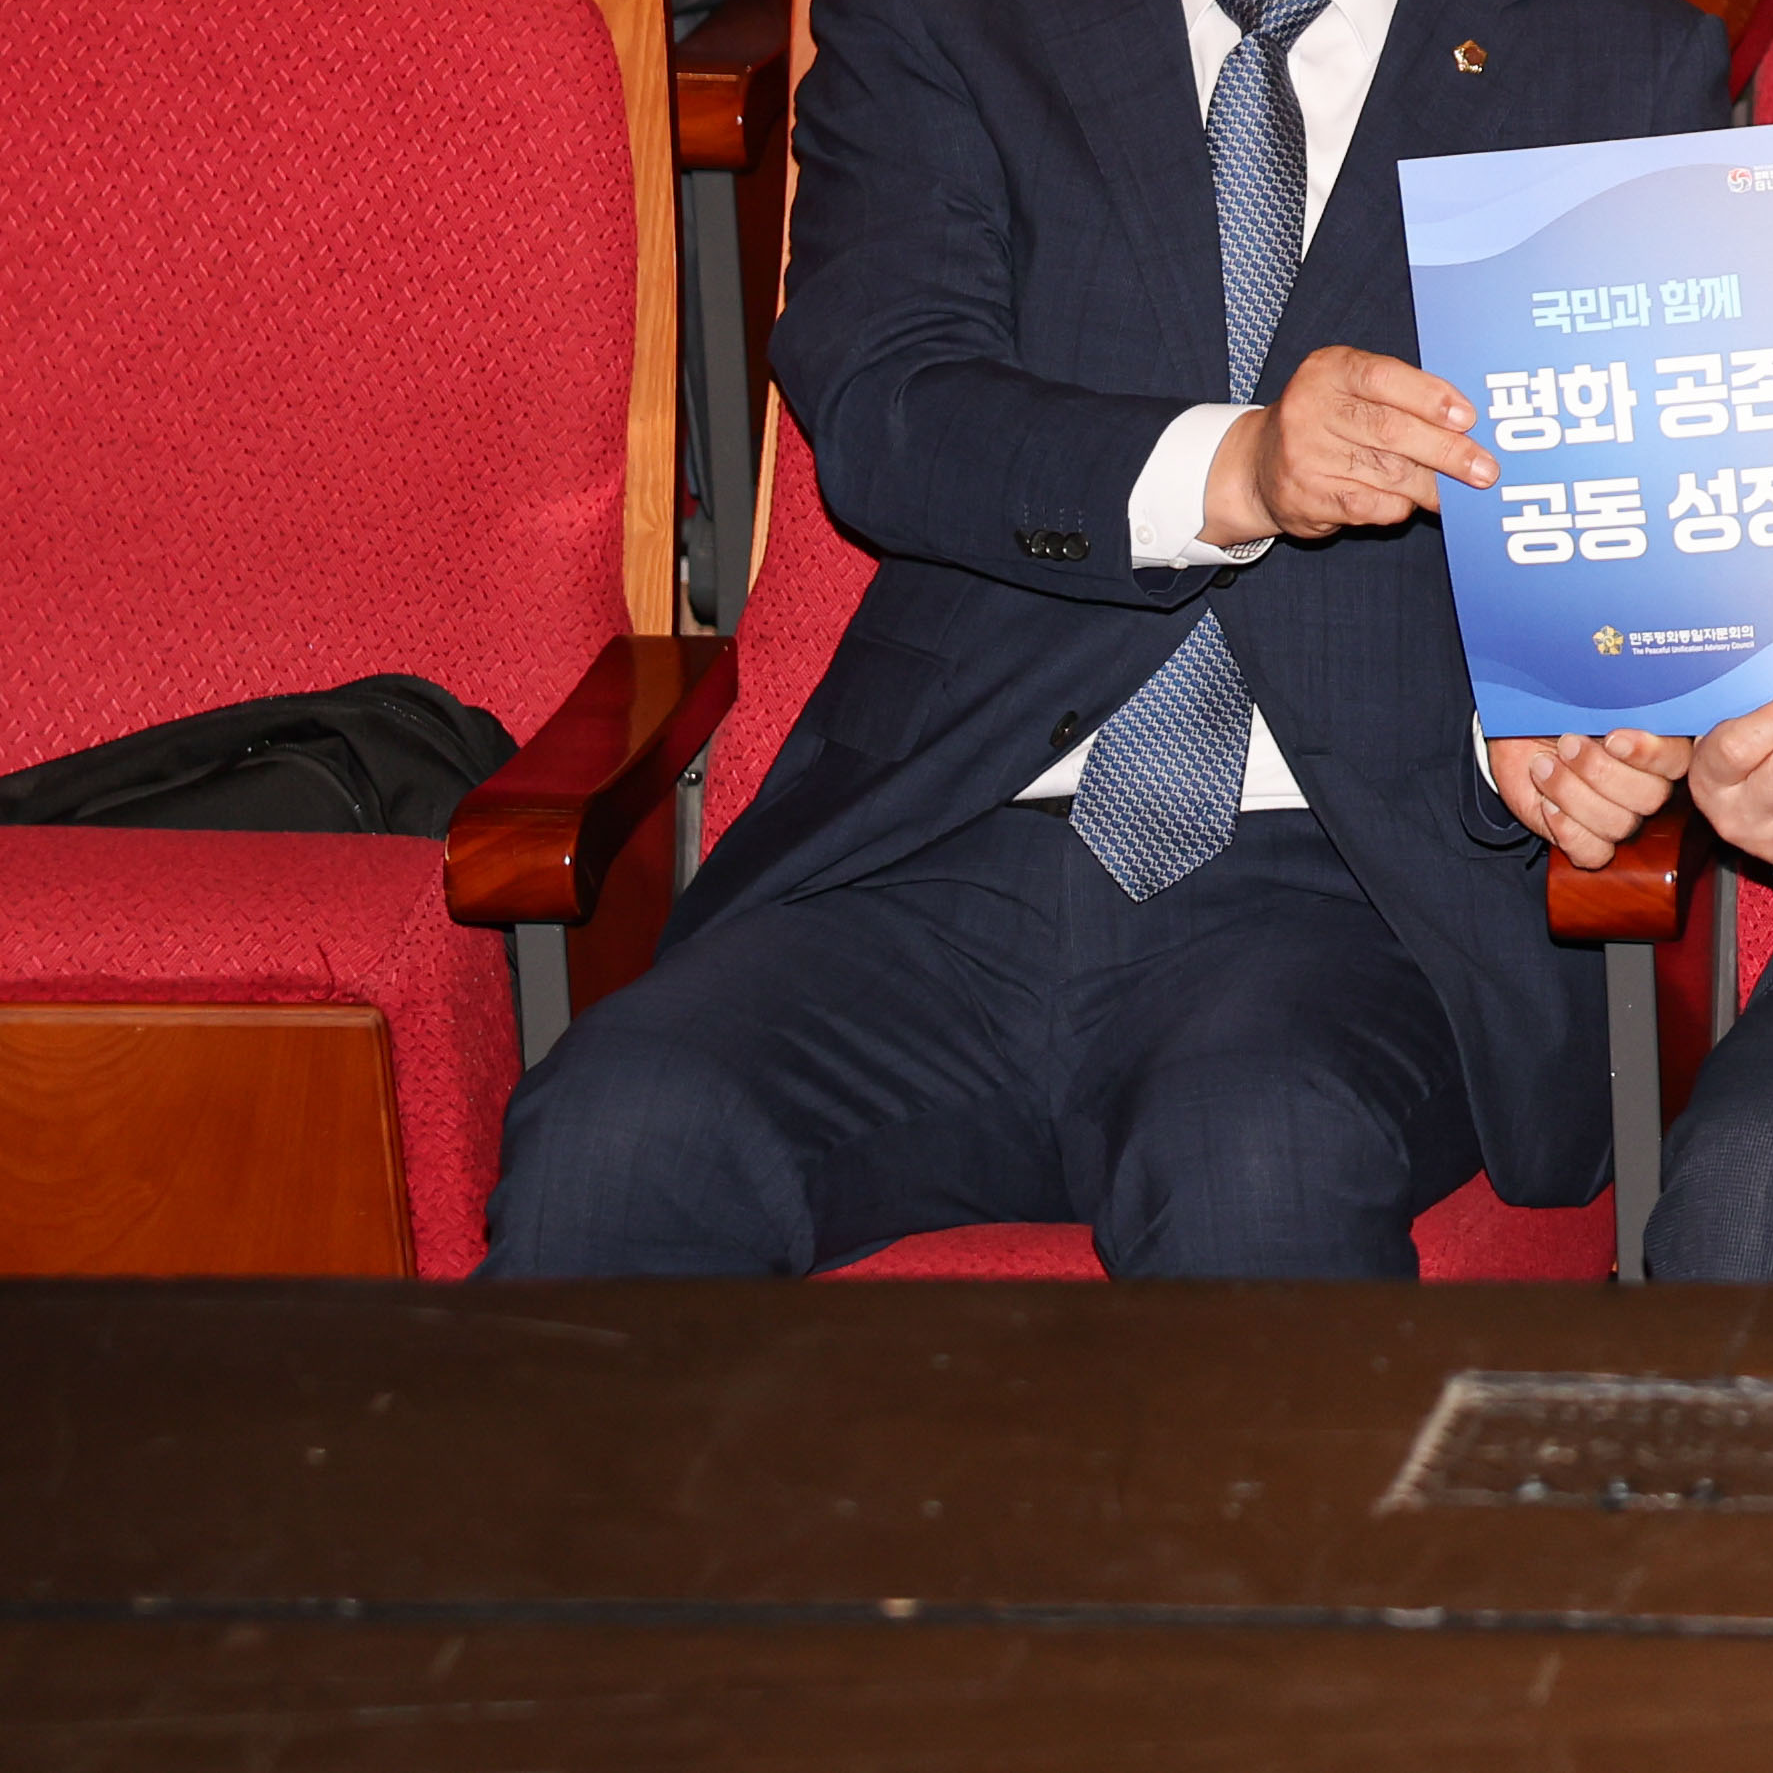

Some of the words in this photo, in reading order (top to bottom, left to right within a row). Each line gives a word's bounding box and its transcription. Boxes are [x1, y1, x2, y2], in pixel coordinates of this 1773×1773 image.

[1533, 284, 1652, 333] 국민과
[1659, 274, 1742, 322] 함께
[1486, 362, 1638, 451] 평화
[1502, 477, 1647, 564] 공동
[1629, 625, 1755, 646] 민주평화통일자문회의
